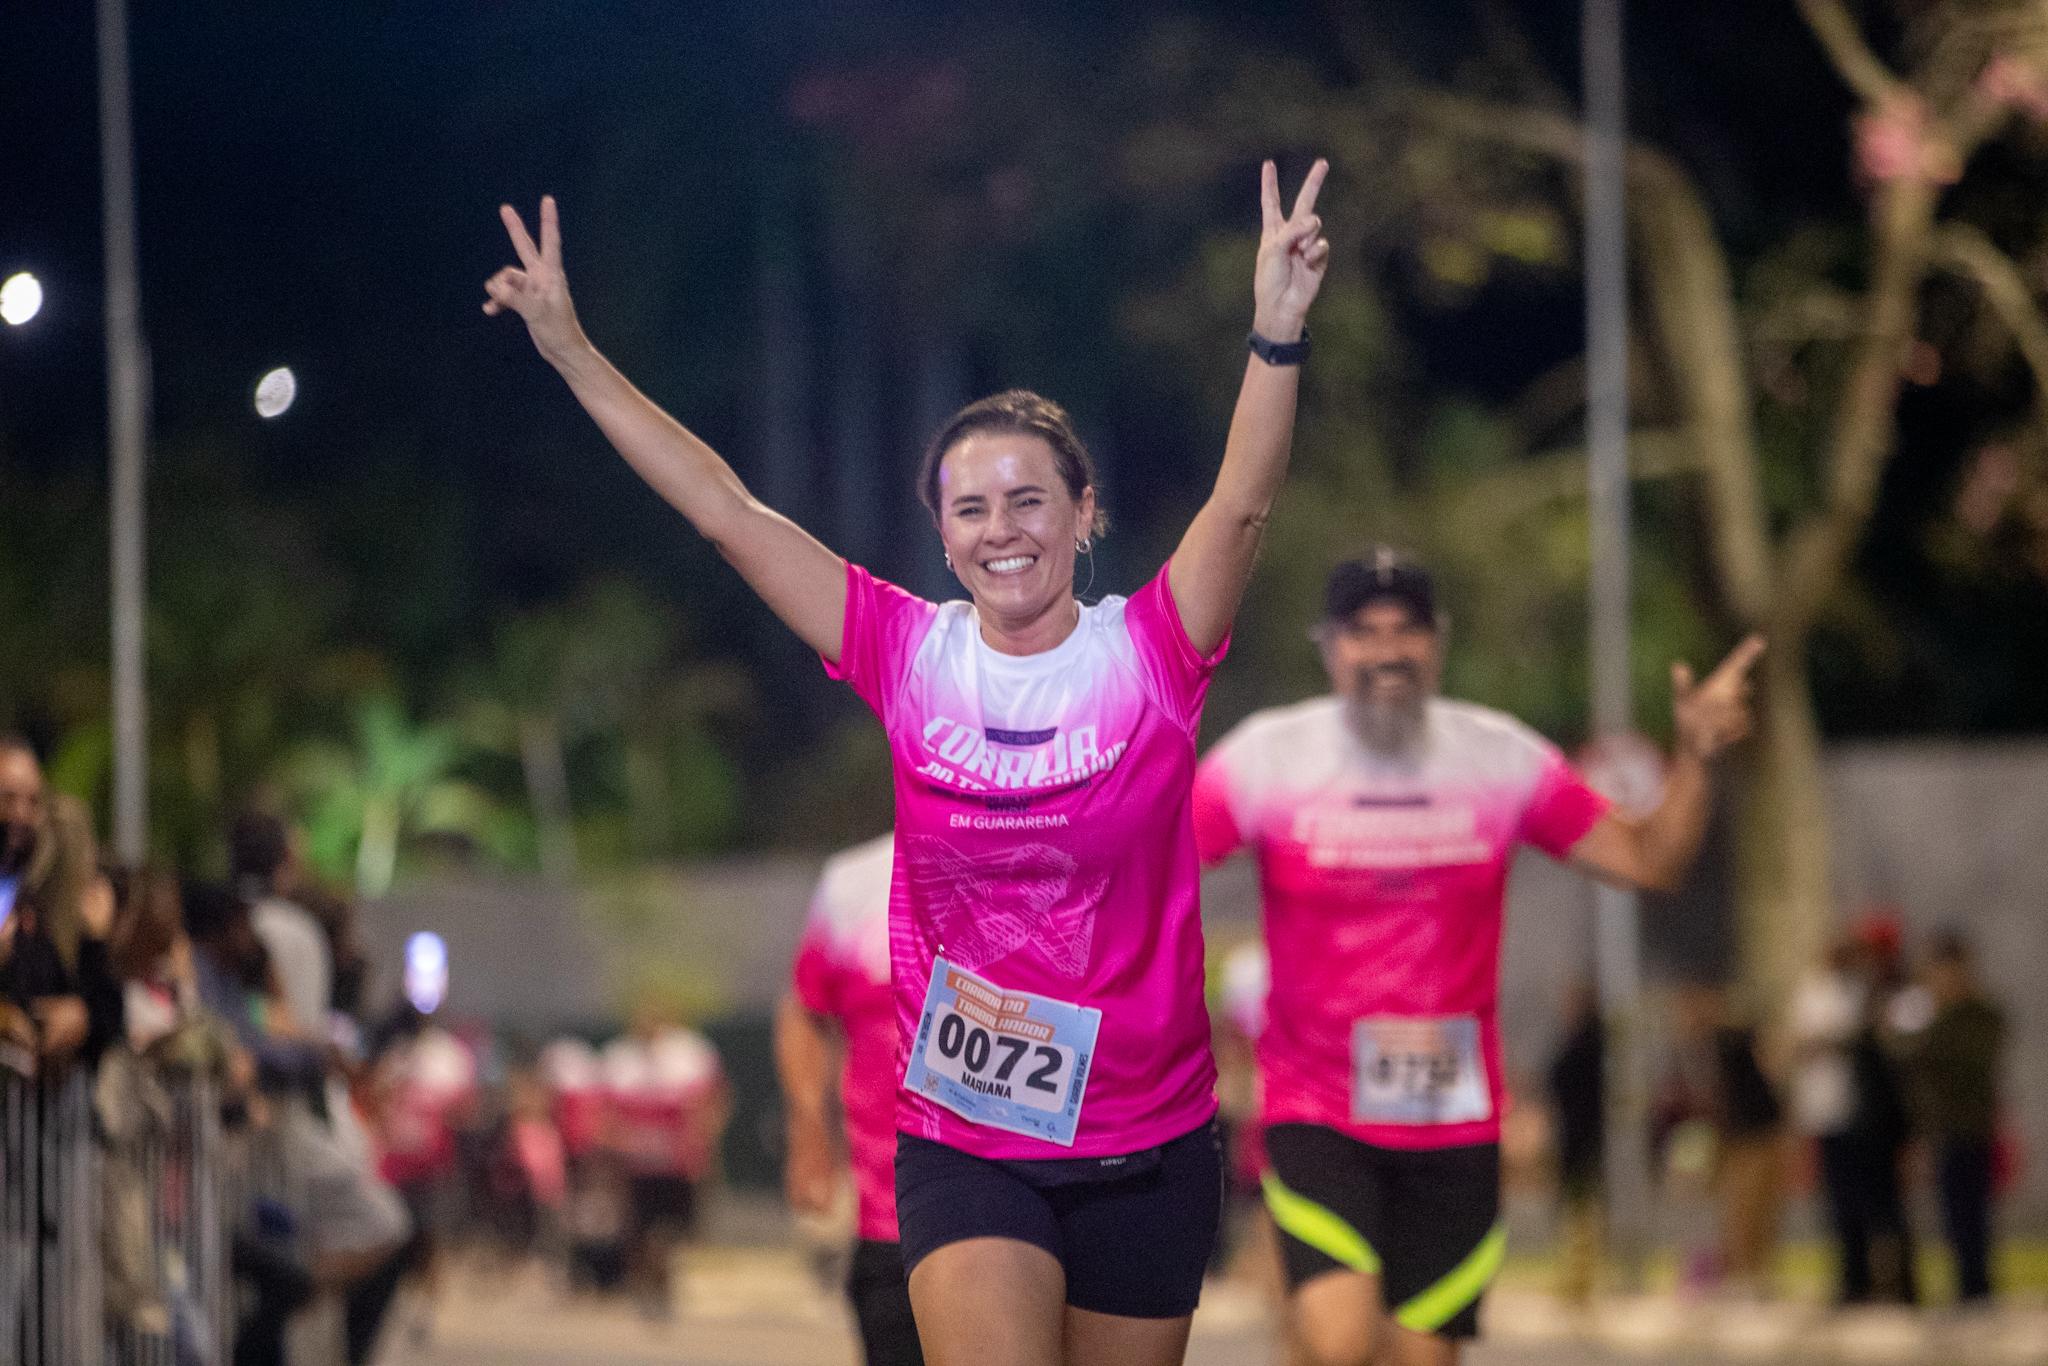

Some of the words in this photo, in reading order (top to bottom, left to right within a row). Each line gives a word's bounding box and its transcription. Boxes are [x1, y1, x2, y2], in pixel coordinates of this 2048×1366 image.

[950, 814, 970, 828] EM
[974, 814, 1069, 830] GUARAREMA
[955, 976, 1001, 1011] CORRIDA
[1002, 999, 1024, 1014] DO
[938, 1014, 1063, 1095] 0072
[961, 1071, 1012, 1100] MARIANA
